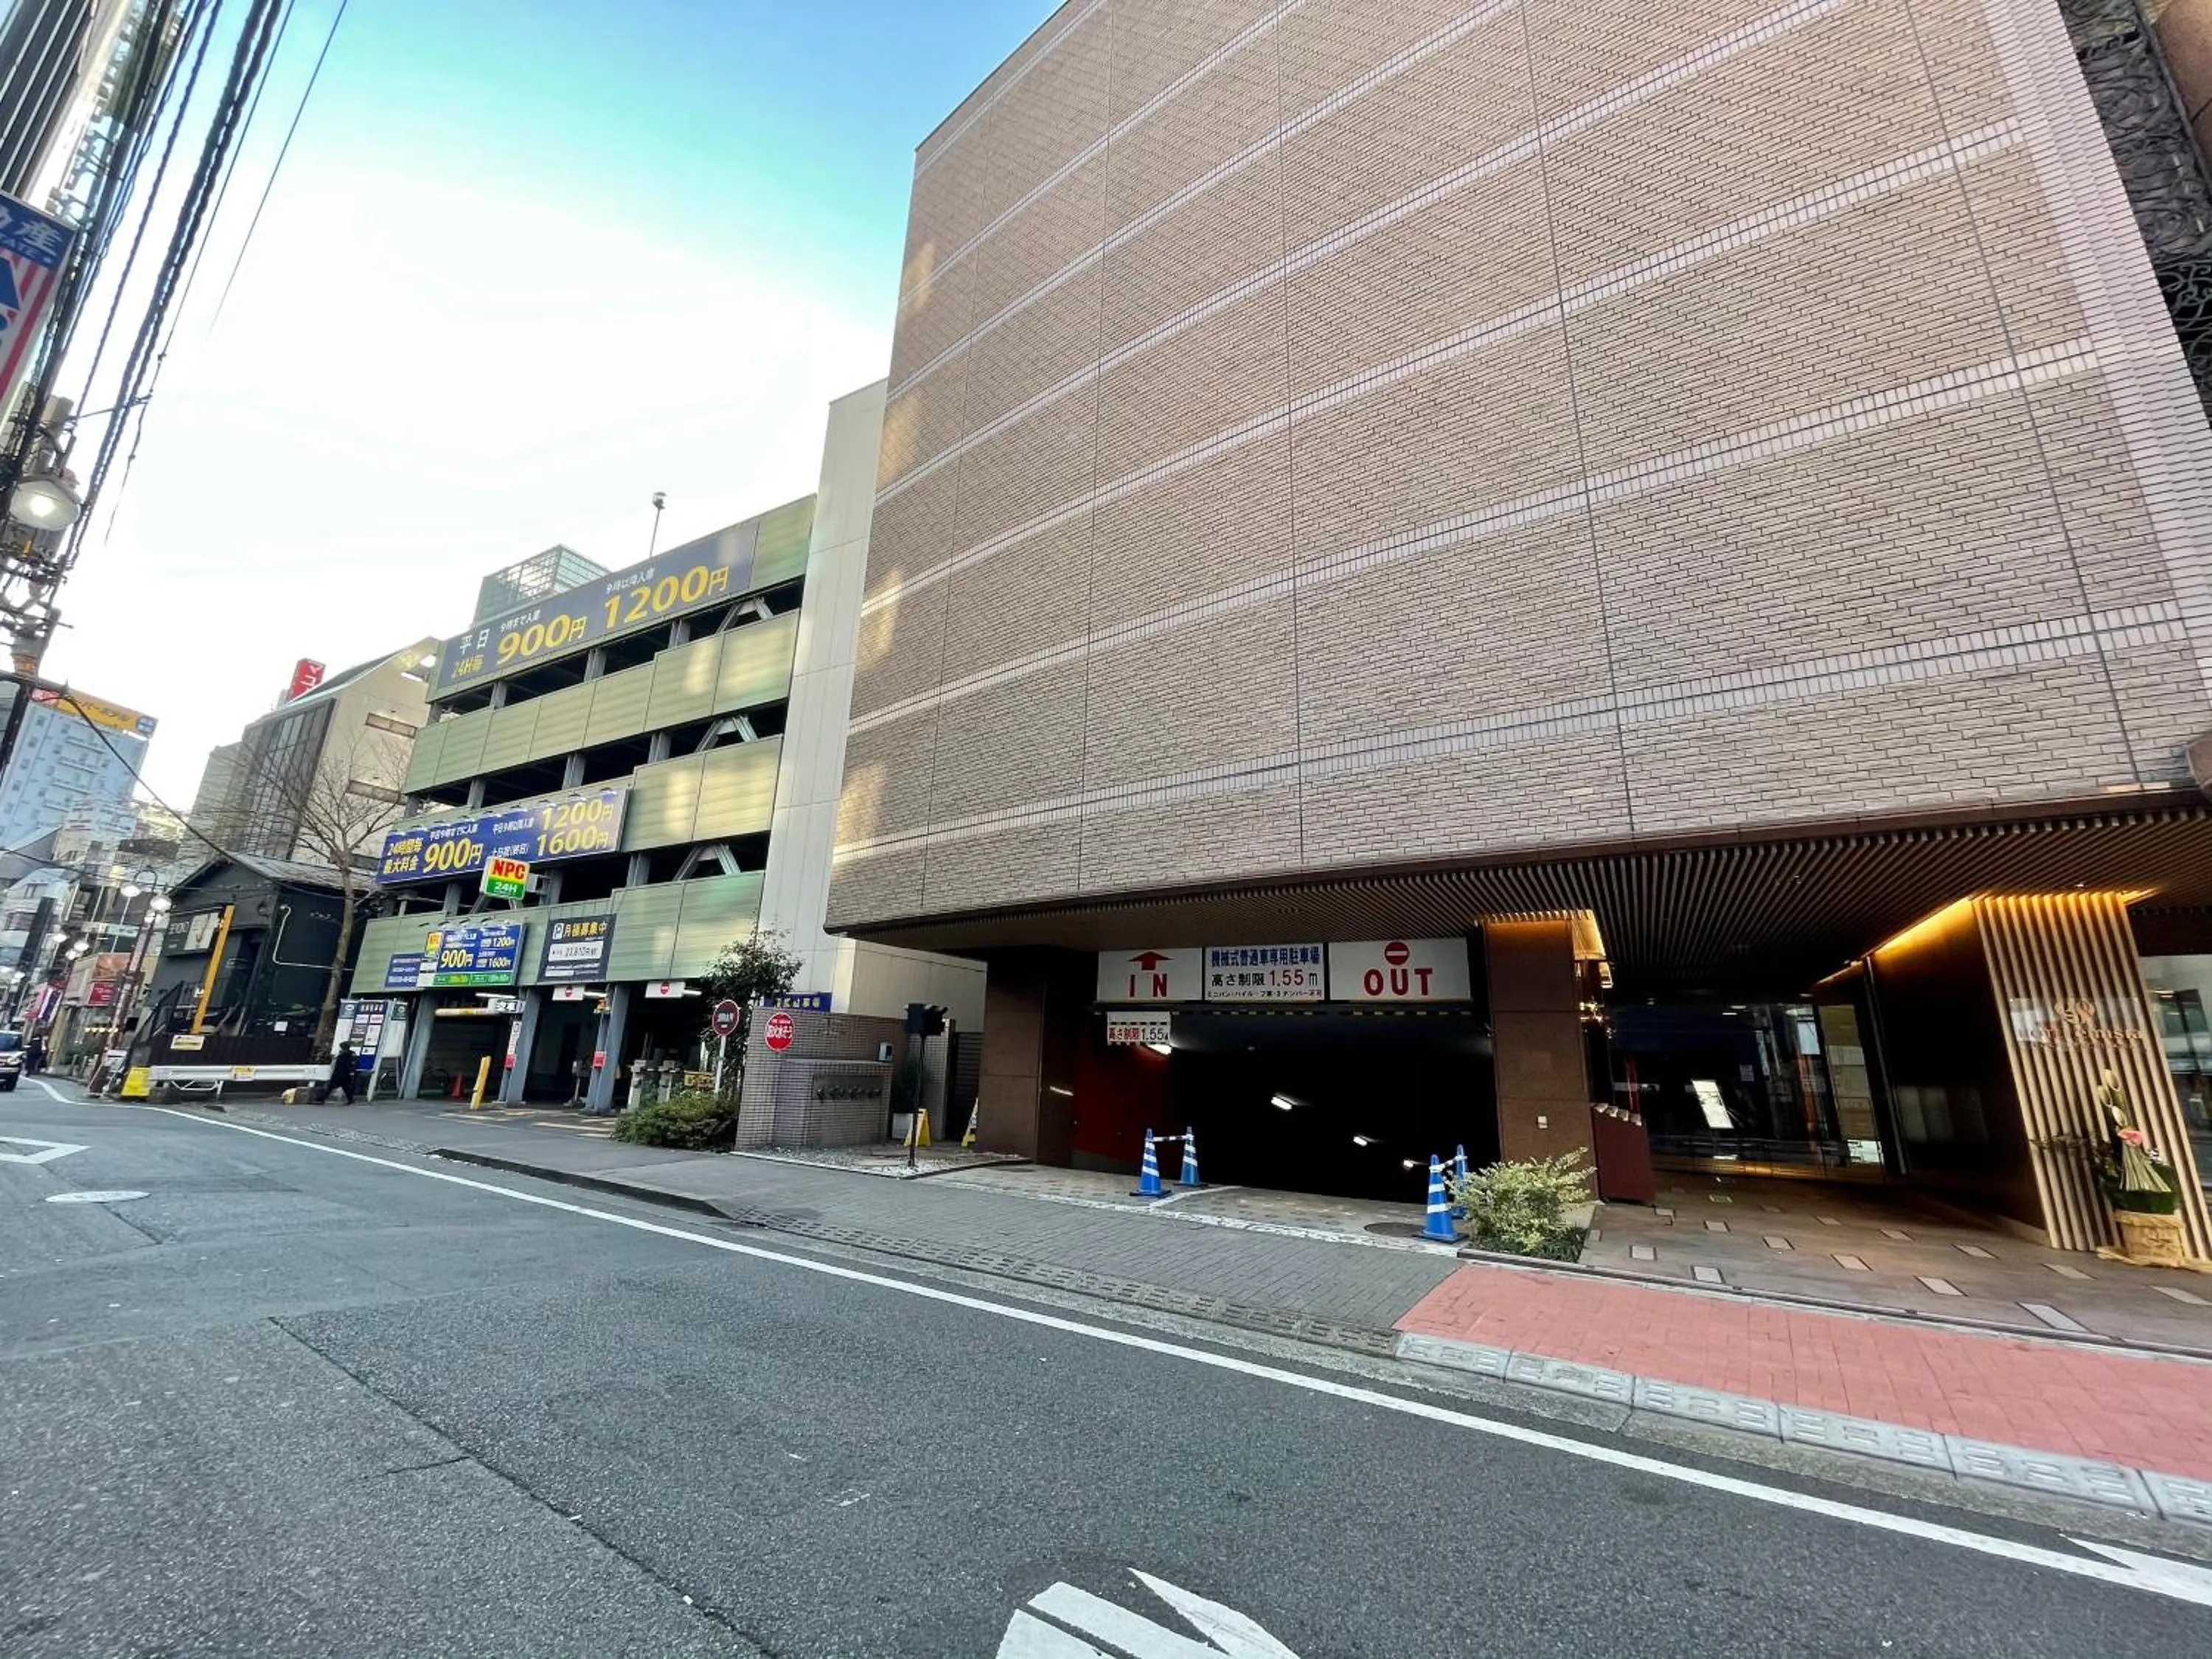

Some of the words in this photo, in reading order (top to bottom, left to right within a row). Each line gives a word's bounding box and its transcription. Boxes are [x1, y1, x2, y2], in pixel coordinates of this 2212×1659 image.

[0, 205, 63, 257] 産
[605, 566, 730, 629] 1200円
[460, 629, 490, 655] 平日
[496, 614, 588, 665] 900円
[542, 799, 614, 830] 1200円
[422, 837, 484, 873] 900円
[537, 825, 608, 857] 1600円
[493, 859, 525, 880] NPC
[494, 881, 518, 893] 24H
[440, 949, 473, 968] 900円
[1129, 973, 1168, 998] IN
[1363, 968, 1433, 996] OUT
